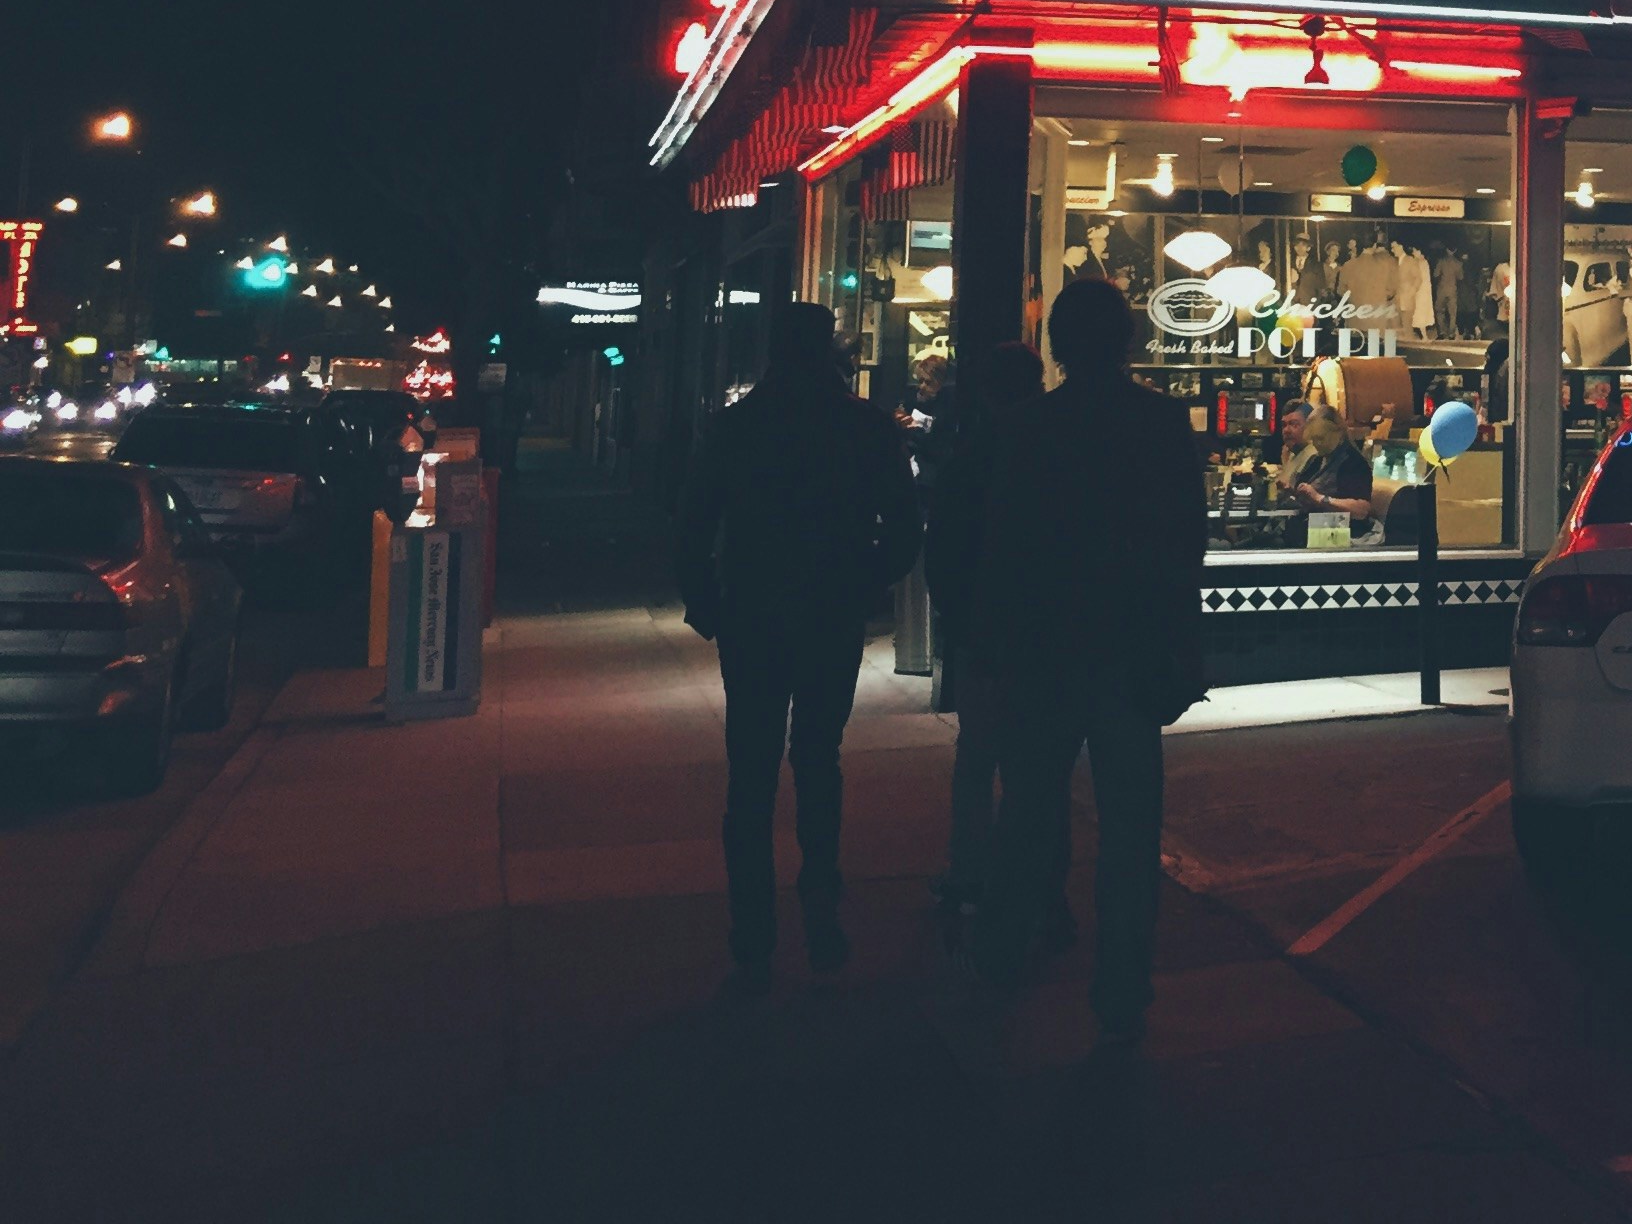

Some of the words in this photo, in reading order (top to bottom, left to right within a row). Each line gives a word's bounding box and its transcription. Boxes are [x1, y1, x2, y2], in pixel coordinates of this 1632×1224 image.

[1407, 200, 1451, 214] Espresso
[1249, 289, 1399, 320] Chicken
[1145, 338, 1187, 354] Fresh
[1189, 339, 1235, 354] Baked
[1237, 327, 1323, 358] POT
